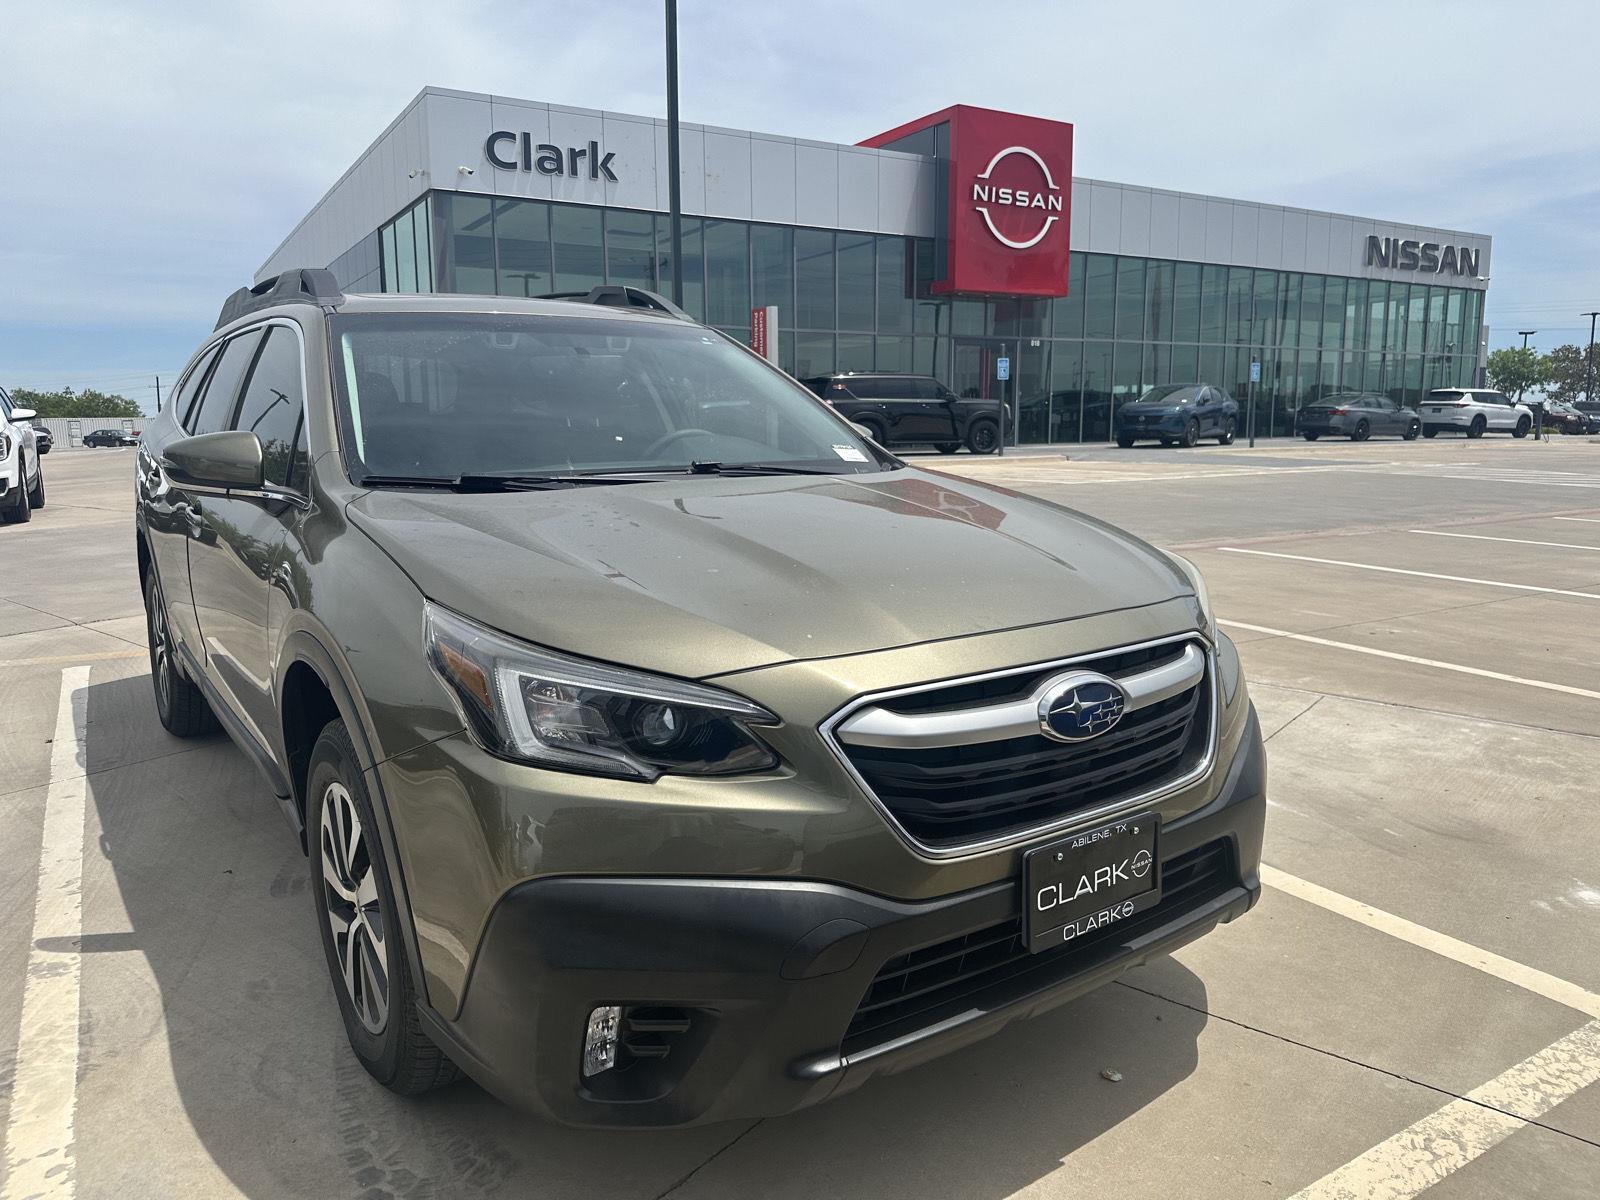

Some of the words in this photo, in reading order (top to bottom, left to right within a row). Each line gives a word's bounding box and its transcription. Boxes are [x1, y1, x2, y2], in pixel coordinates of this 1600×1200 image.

[485, 130, 619, 183] Clark
[973, 184, 1062, 212] NISSAN
[1367, 235, 1480, 277] NISSAN
[1071, 829, 1112, 849] ABILENE,
[1115, 823, 1127, 834] TX
[1037, 858, 1129, 912] CLARK
[1063, 905, 1122, 941] CLARK
